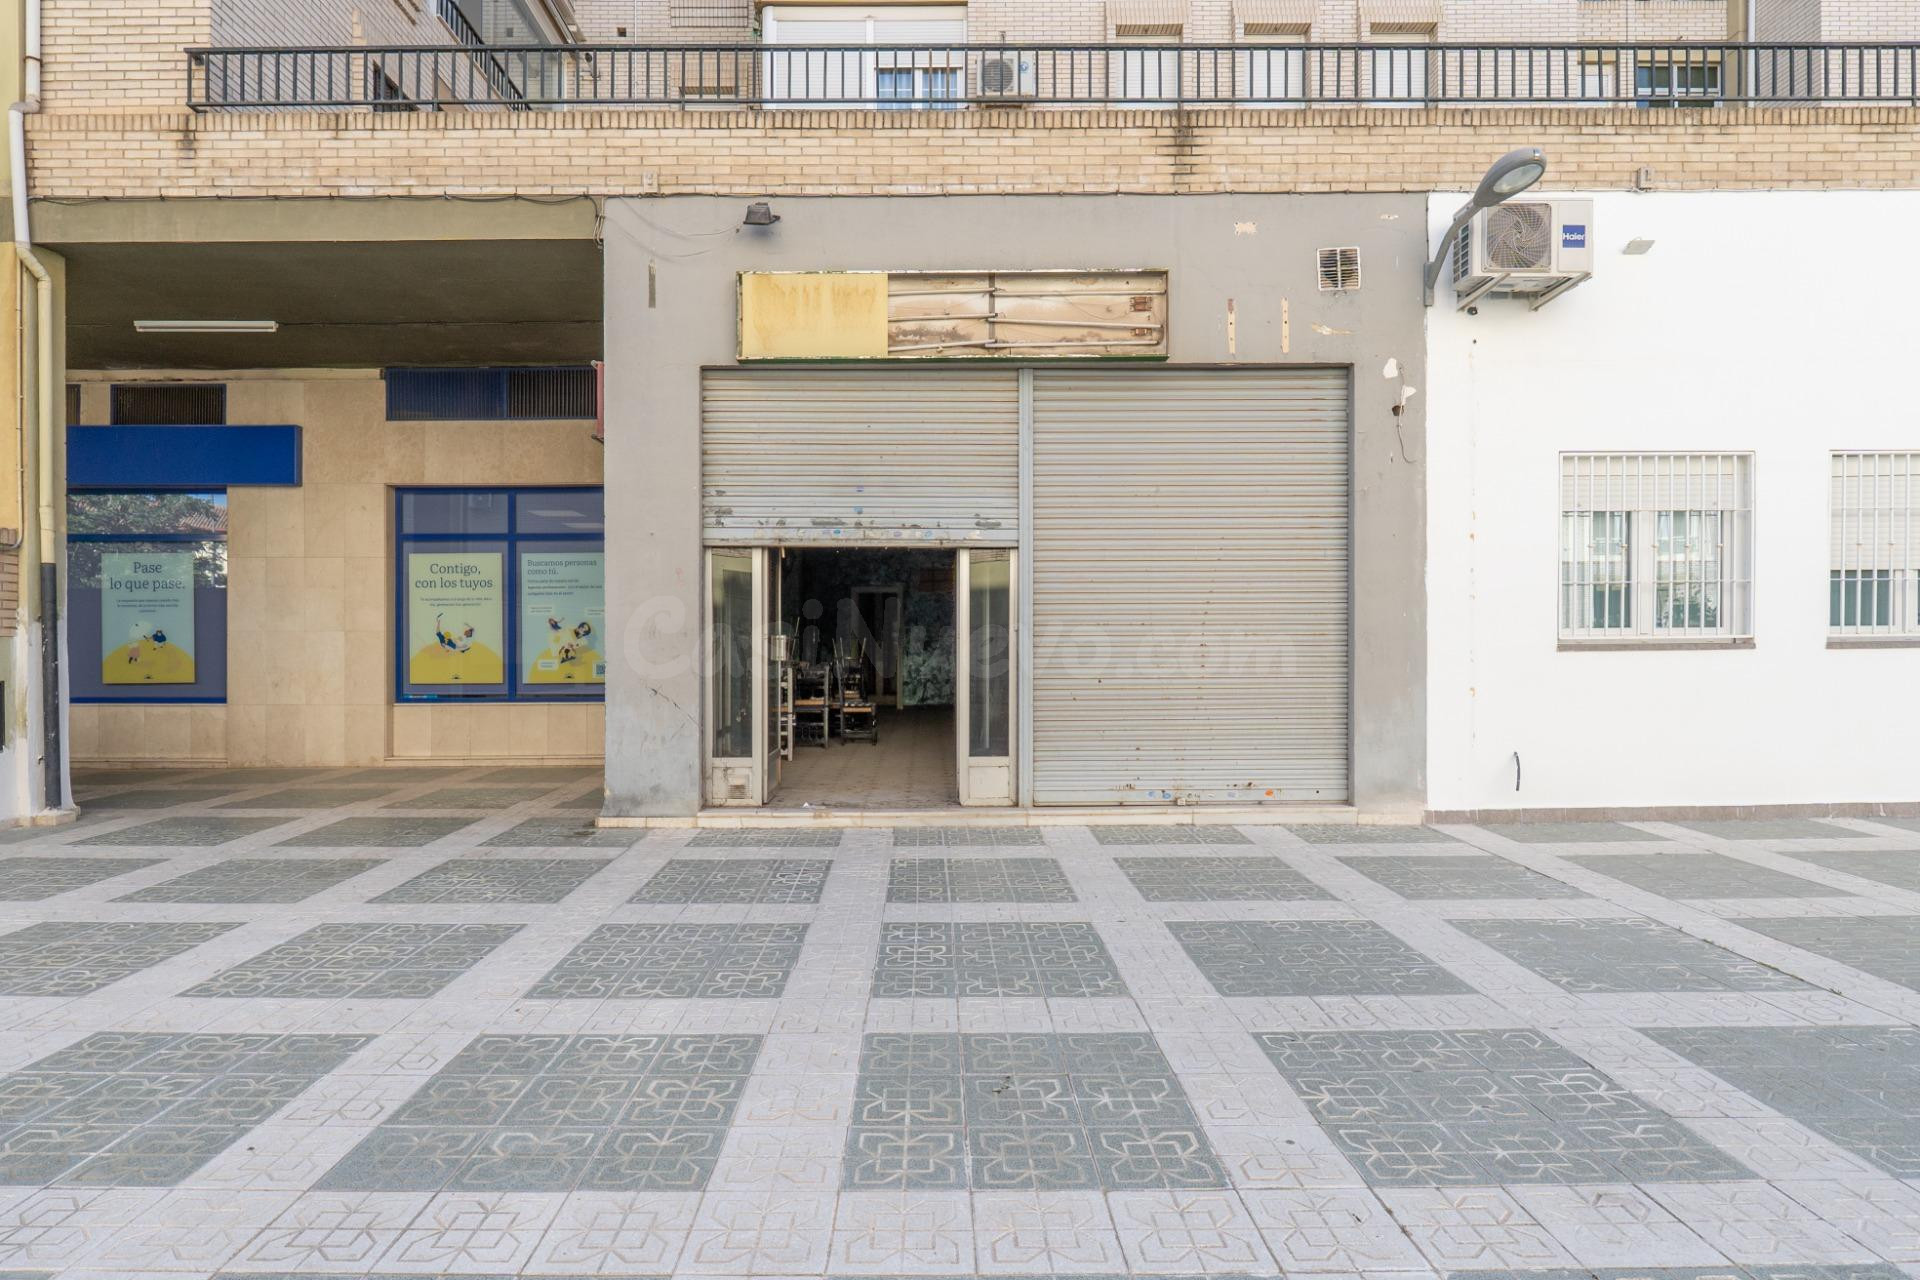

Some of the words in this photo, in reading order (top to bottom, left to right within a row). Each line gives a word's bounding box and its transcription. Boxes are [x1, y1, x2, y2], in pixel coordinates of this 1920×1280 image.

[1563, 232, 1585, 240] Haier
[134, 561, 162, 573] Pase
[430, 562, 481, 576] Contigo,
[527, 559, 563, 567] Buscamos
[565, 559, 597, 568] personas
[110, 577, 122, 590] lo
[125, 579, 149, 592] que
[152, 579, 185, 592] pase.
[415, 578, 437, 589] con
[440, 577, 457, 589] los
[460, 578, 493, 590] tuyos
